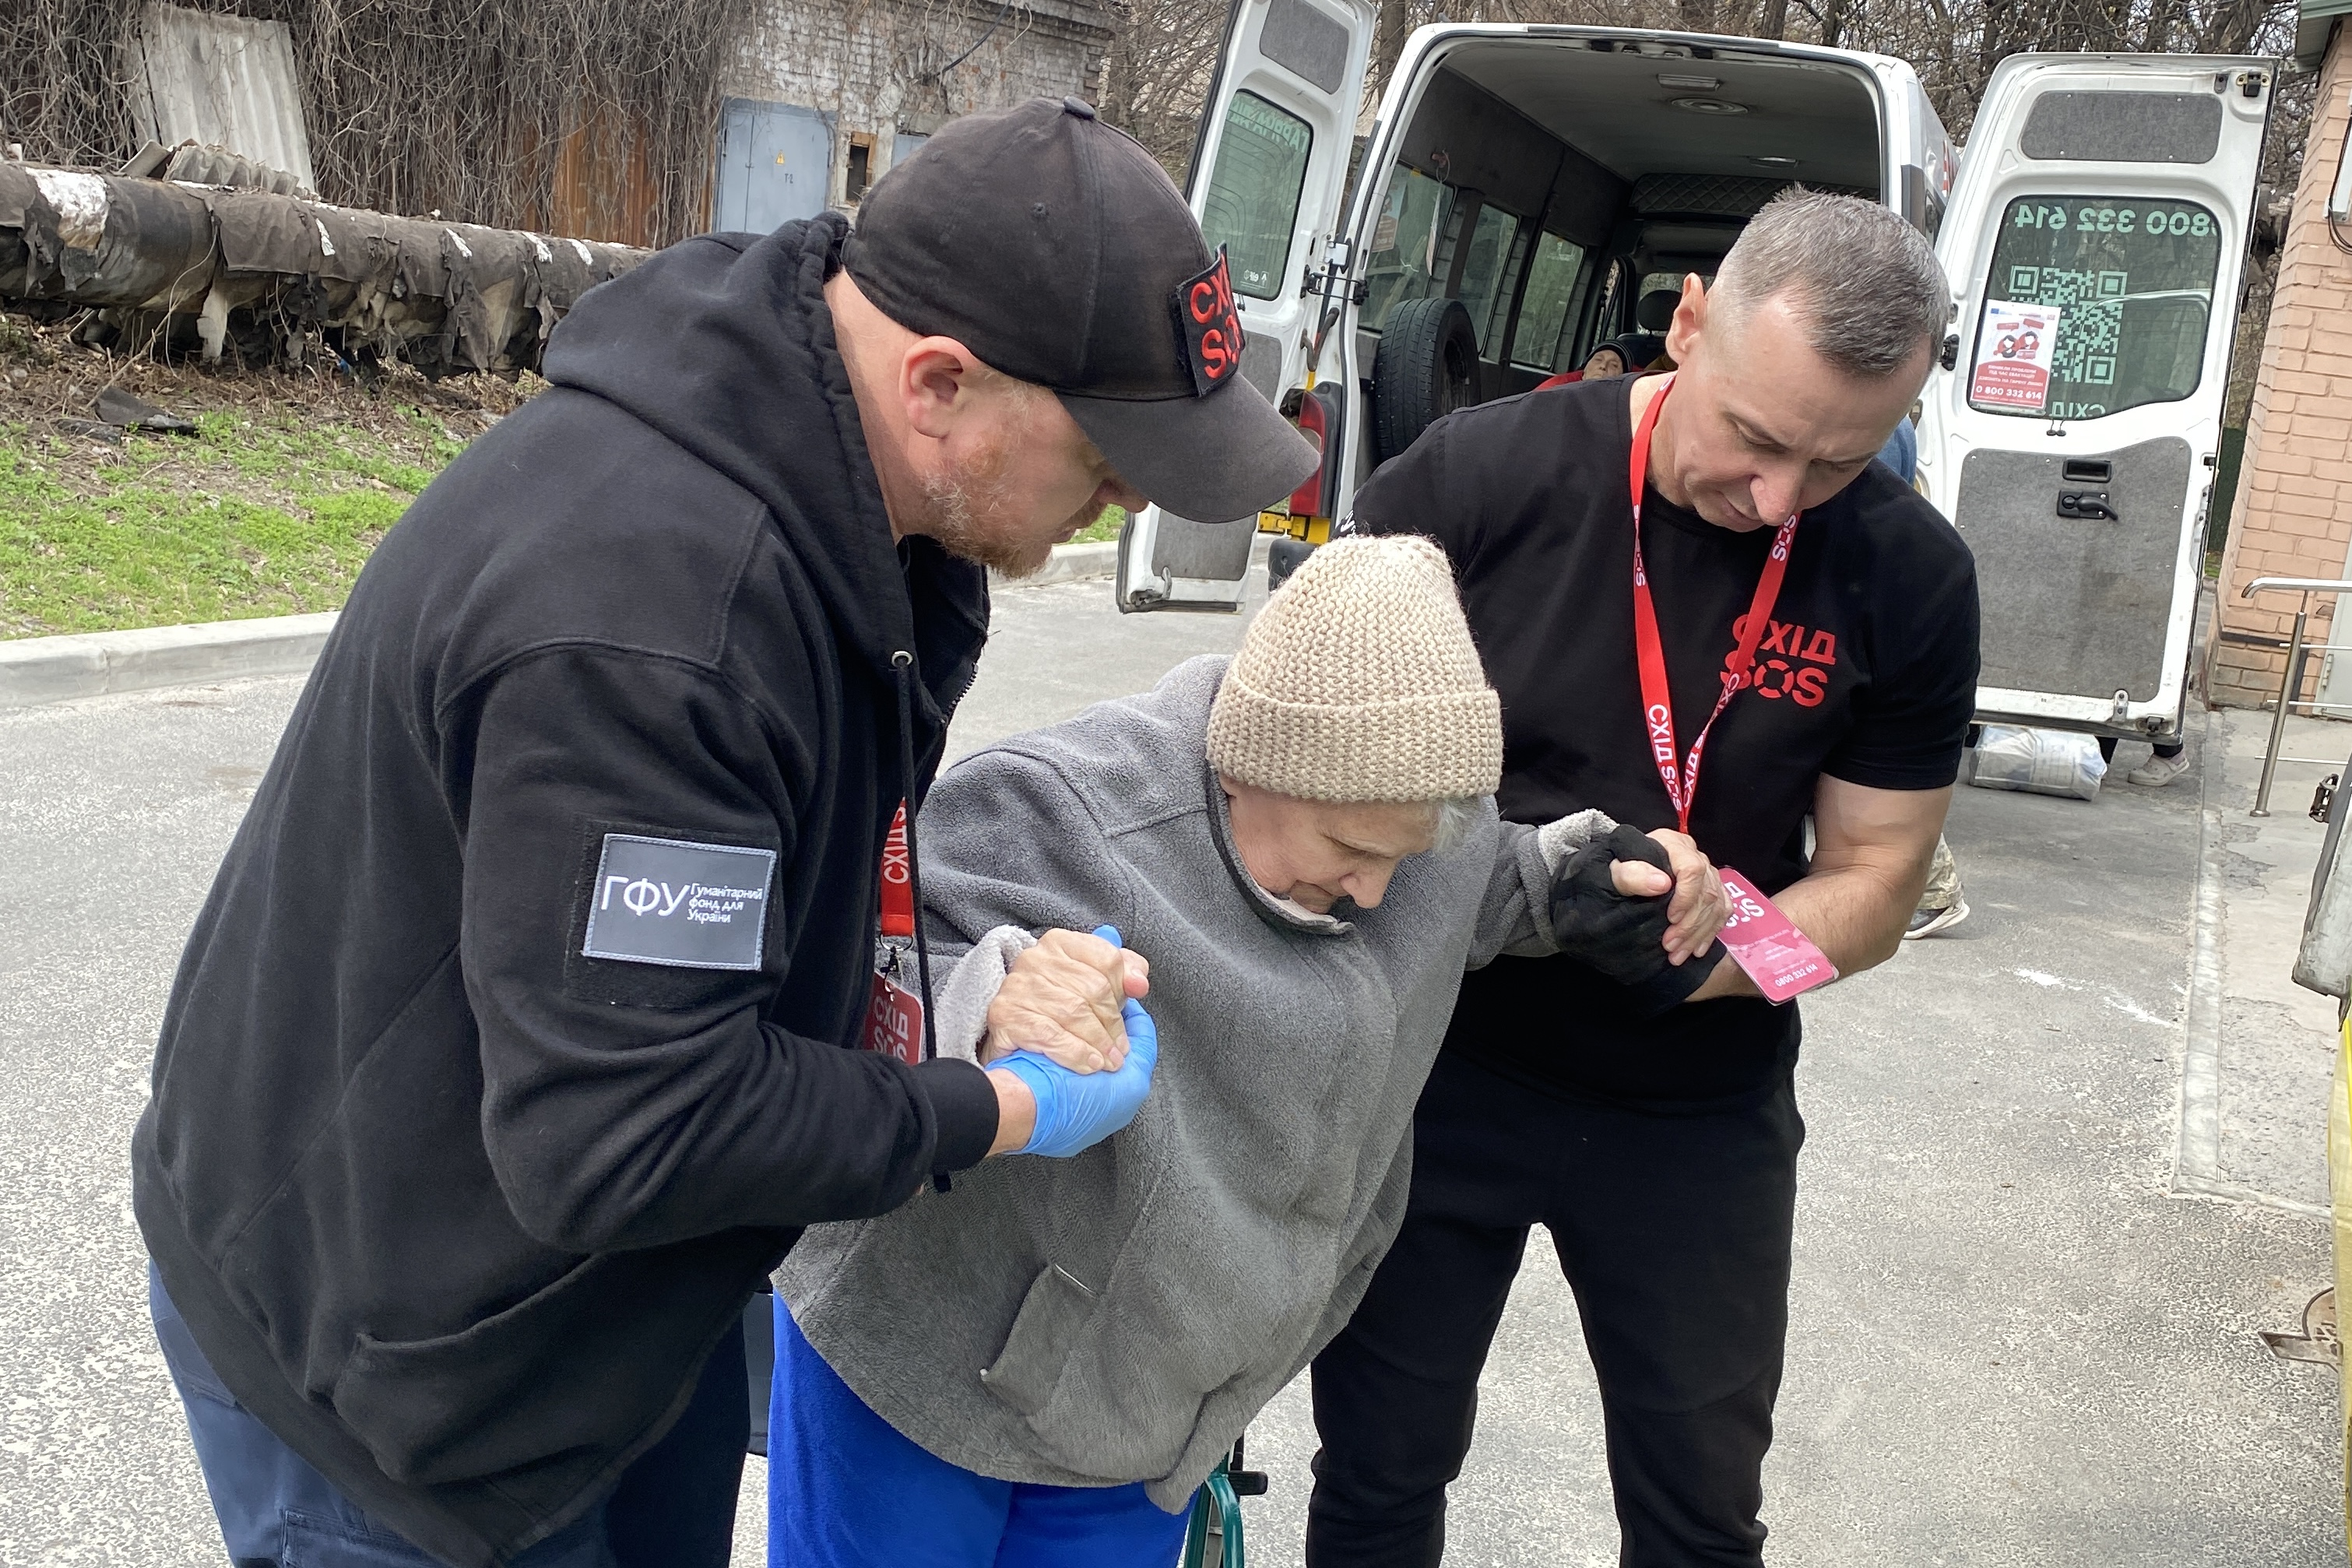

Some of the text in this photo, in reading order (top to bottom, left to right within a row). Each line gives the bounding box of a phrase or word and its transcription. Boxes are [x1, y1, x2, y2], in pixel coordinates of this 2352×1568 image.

[1985, 386, 2004, 396] 800
[2006, 388, 2023, 398] 332
[2025, 391, 2042, 399] 614
[1772, 515, 1797, 561] SOS
[1713, 673, 1740, 718] СХІ
[1648, 704, 1682, 812] СХІД SOS
[884, 824, 909, 884] СХІД
[600, 875, 691, 916] ГФУ
[688, 896, 744, 912] фонд для
[690, 883, 763, 901] Гуманітарний
[687, 909, 732, 924] України
[1774, 973, 1795, 987] 0800
[1792, 968, 1807, 979] 332
